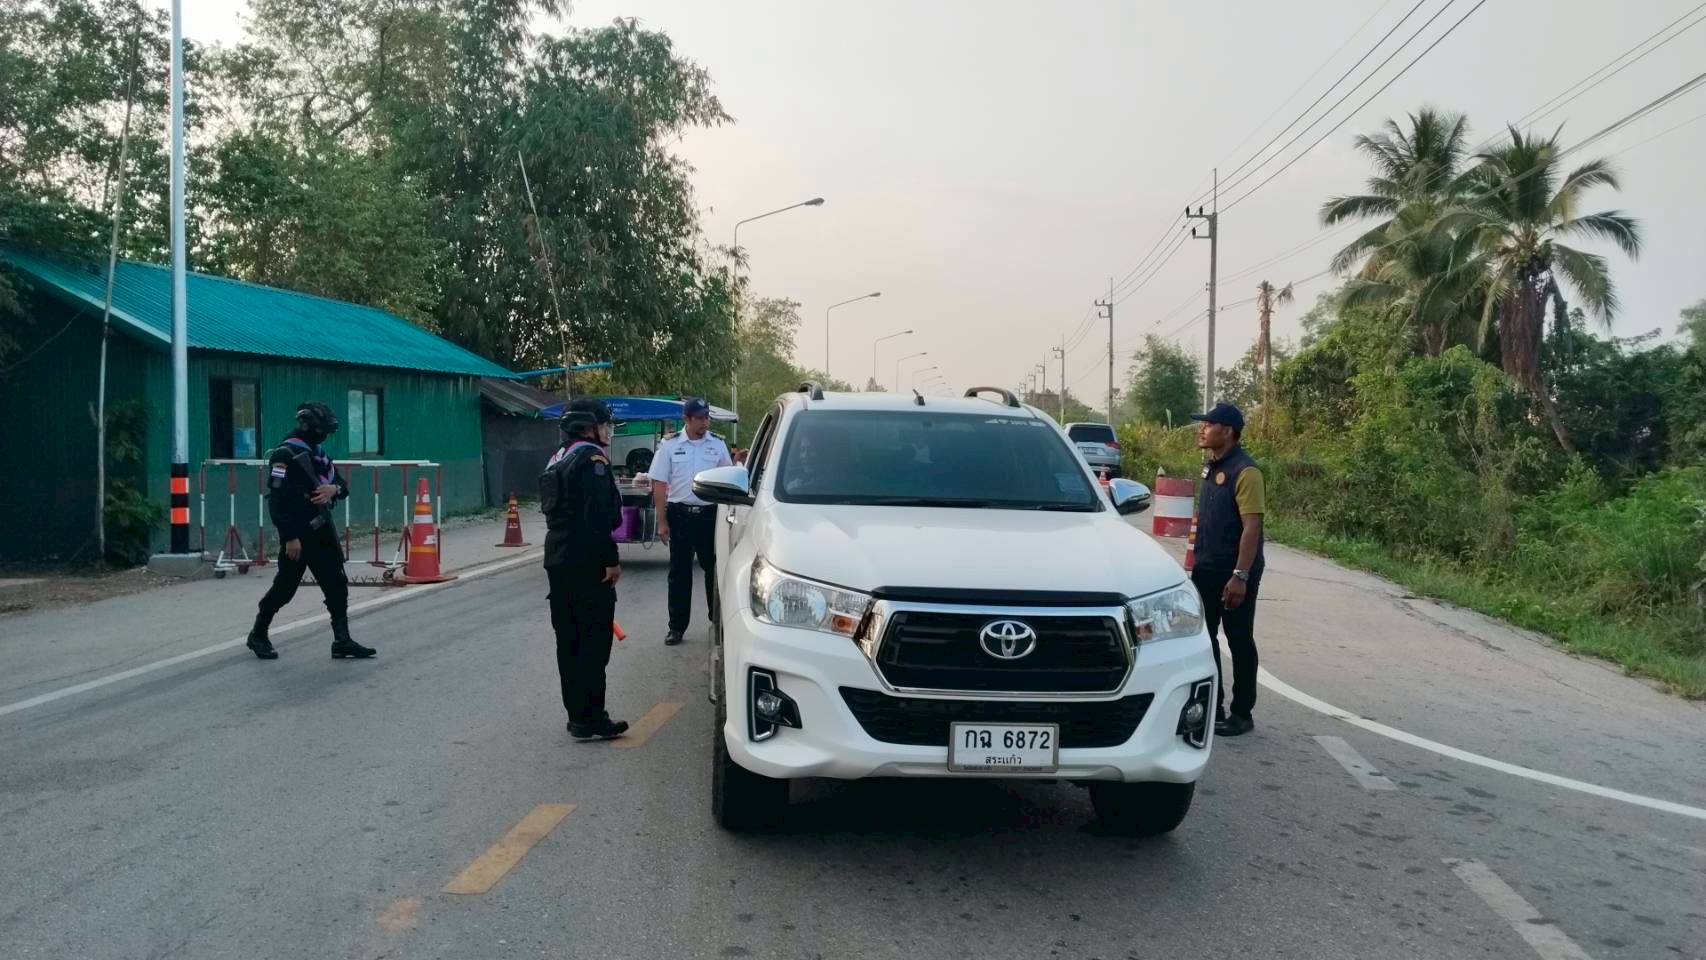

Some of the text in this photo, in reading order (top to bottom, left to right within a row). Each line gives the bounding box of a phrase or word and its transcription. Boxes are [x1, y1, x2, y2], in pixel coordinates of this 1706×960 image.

[965, 730, 1050, 749] กฉ 6872
[985, 754, 1022, 765] สระแก้ว
